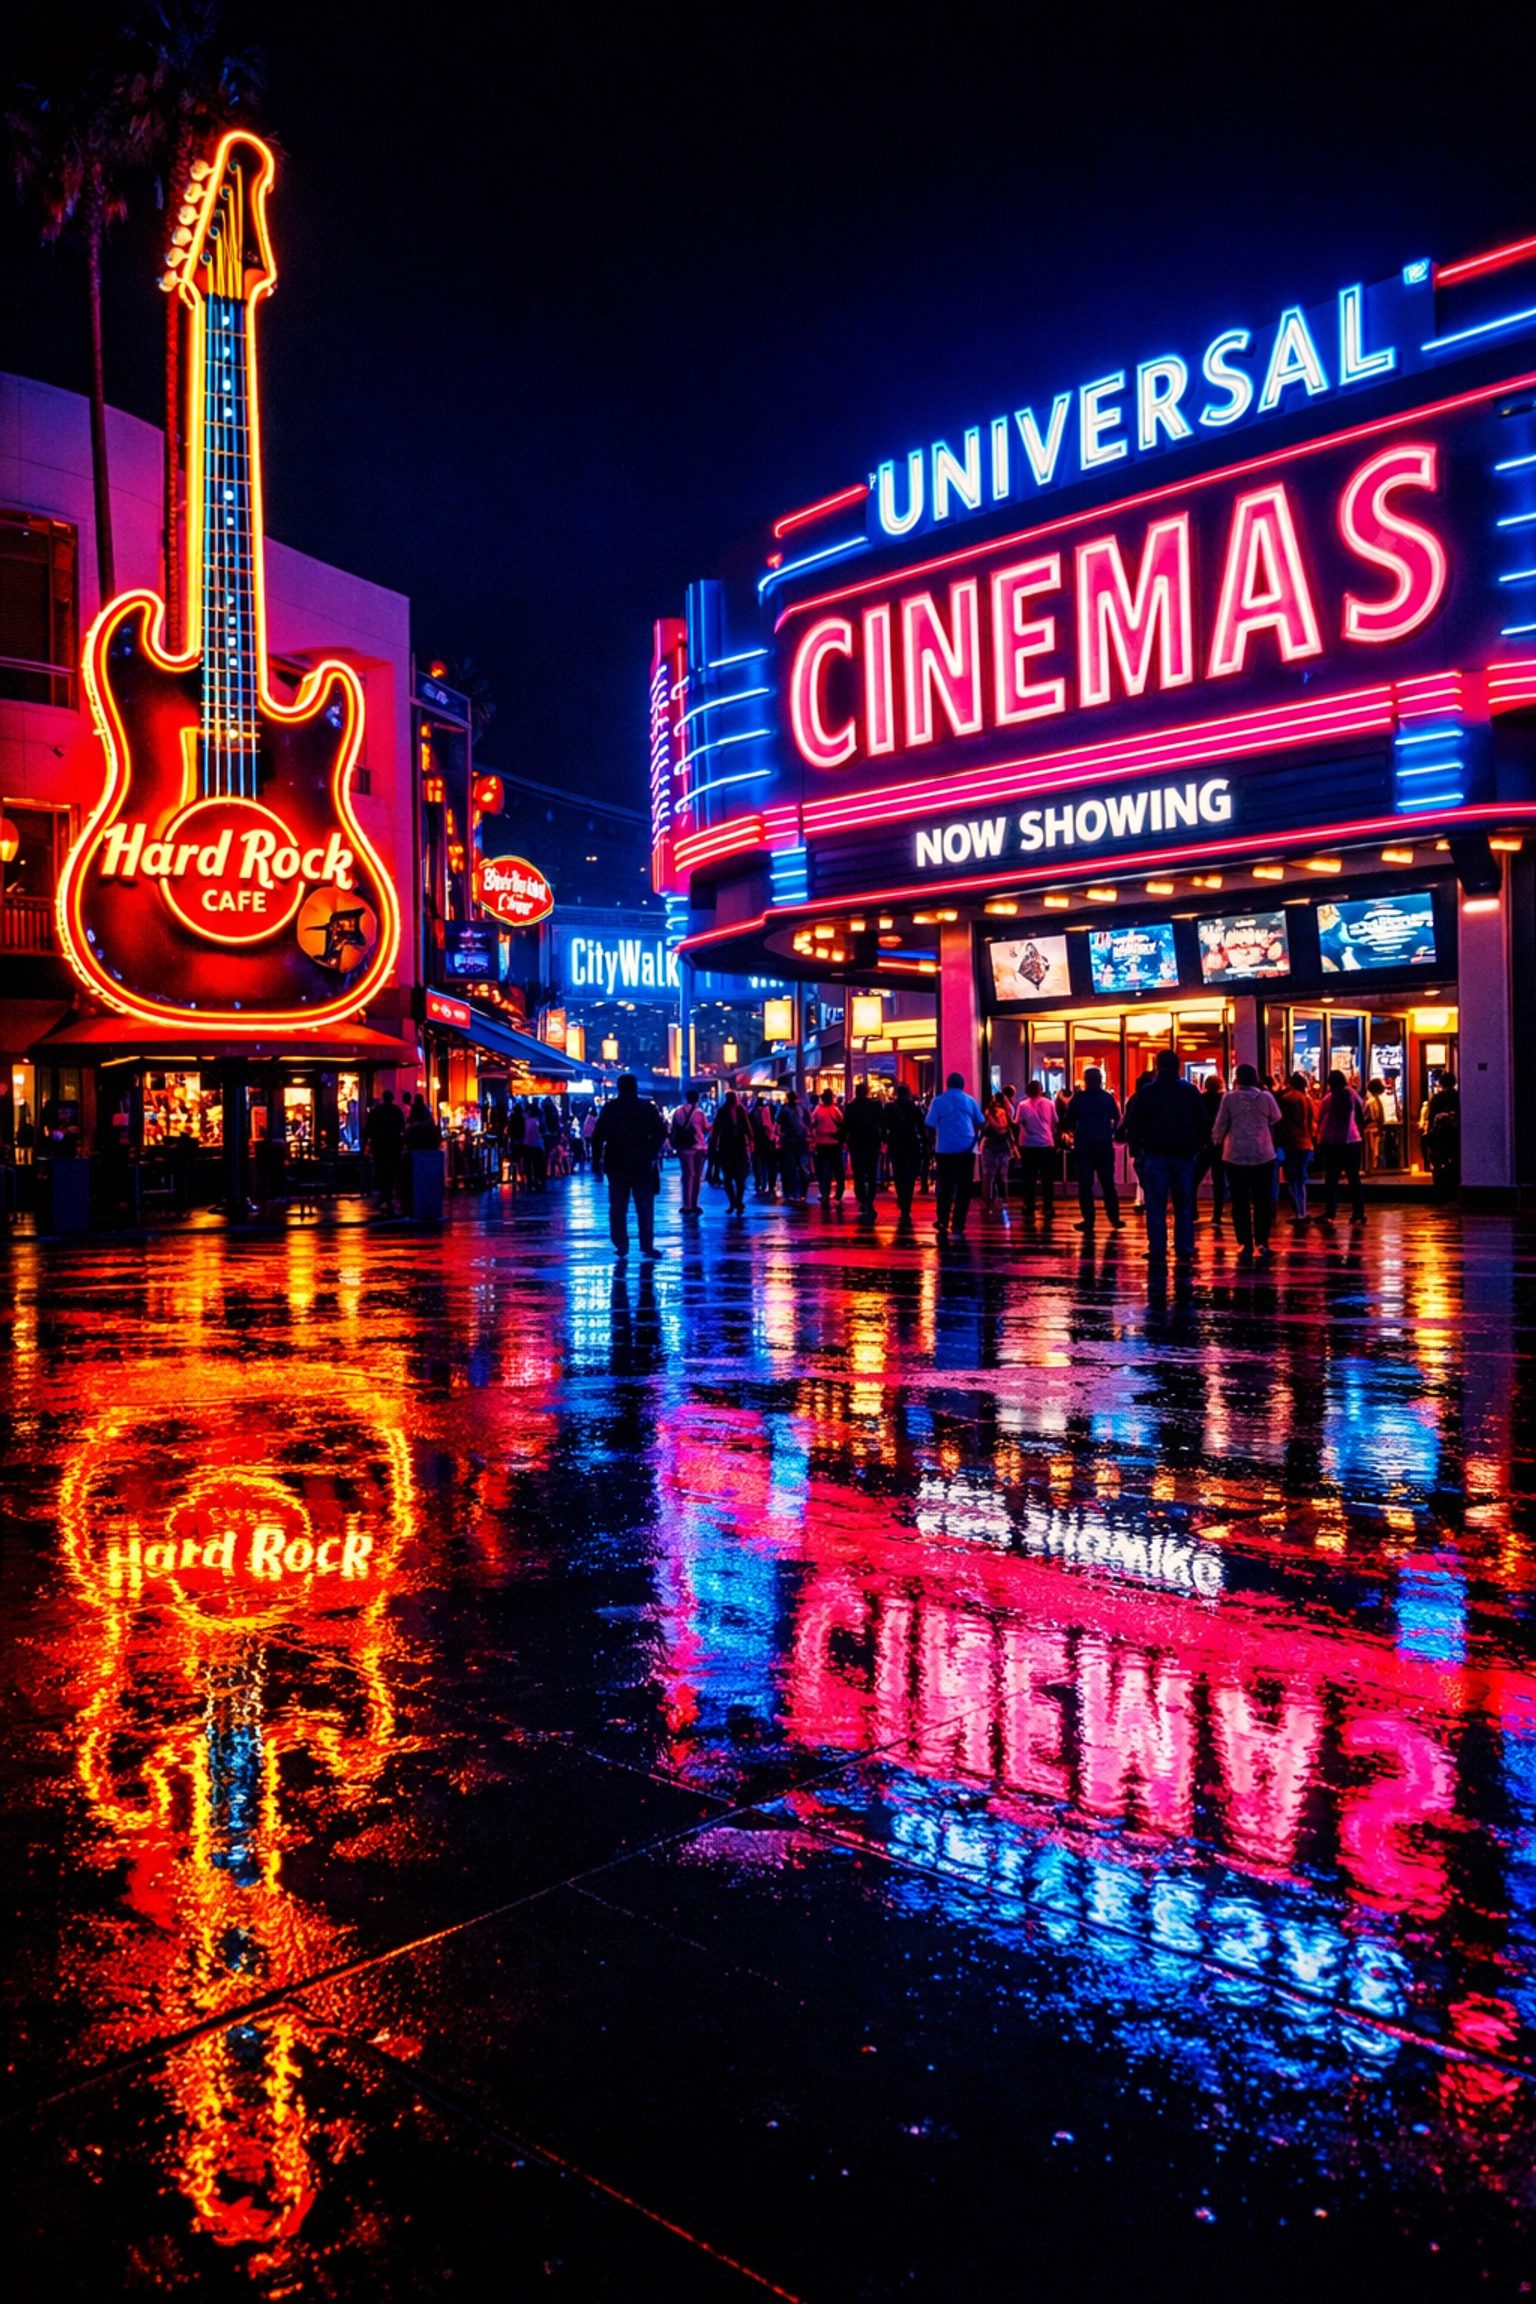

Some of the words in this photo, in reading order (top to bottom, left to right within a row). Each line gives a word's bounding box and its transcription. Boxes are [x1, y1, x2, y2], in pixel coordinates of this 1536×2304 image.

[874, 282, 1396, 537] UNIVERSAL
[789, 441, 1447, 769] CINEMAS
[101, 822, 234, 877] Hard
[238, 828, 354, 891] Rock
[915, 816, 1006, 868] NOW
[1019, 778, 1232, 851] SHOWING
[202, 889, 267, 913] CAFE
[571, 937, 681, 995] CityWalk
